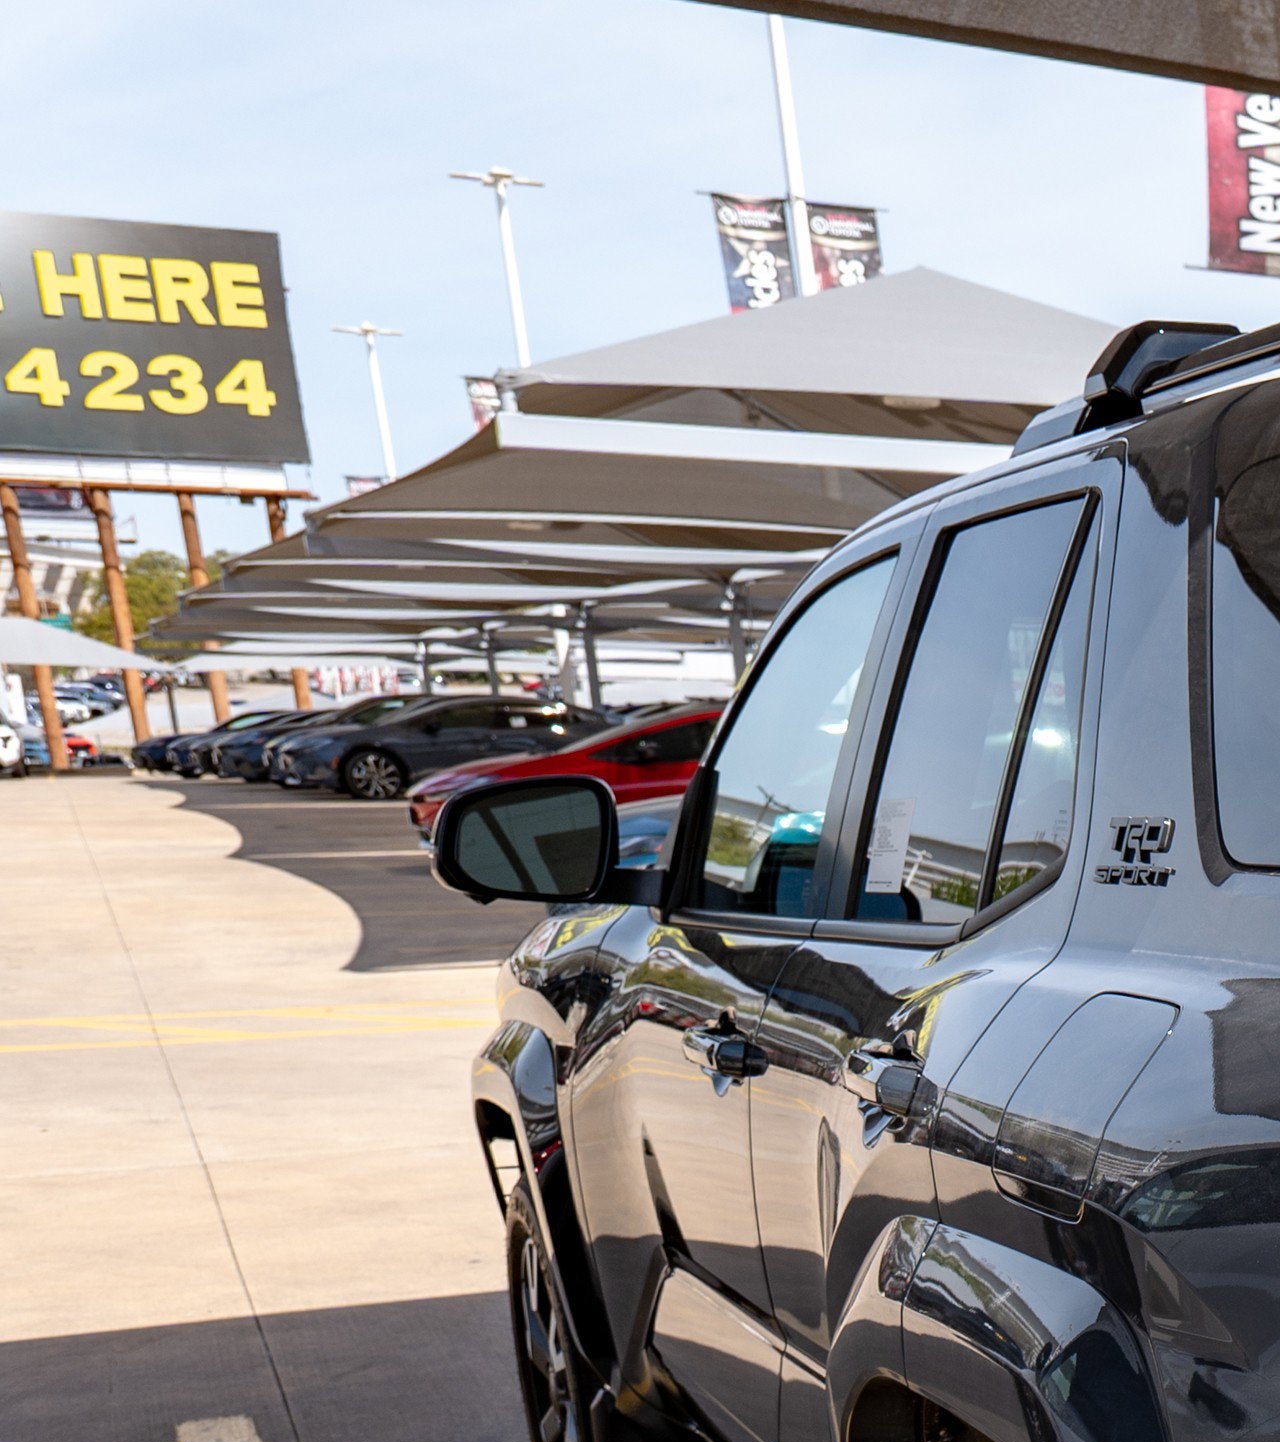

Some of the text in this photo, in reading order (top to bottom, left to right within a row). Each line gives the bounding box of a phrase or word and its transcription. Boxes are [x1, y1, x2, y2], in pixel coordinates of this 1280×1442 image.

[33, 249, 268, 328] HERE
[5, 347, 277, 417] 4234
[1110, 816, 1175, 863] TRD
[1094, 865, 1176, 887] SPORT
